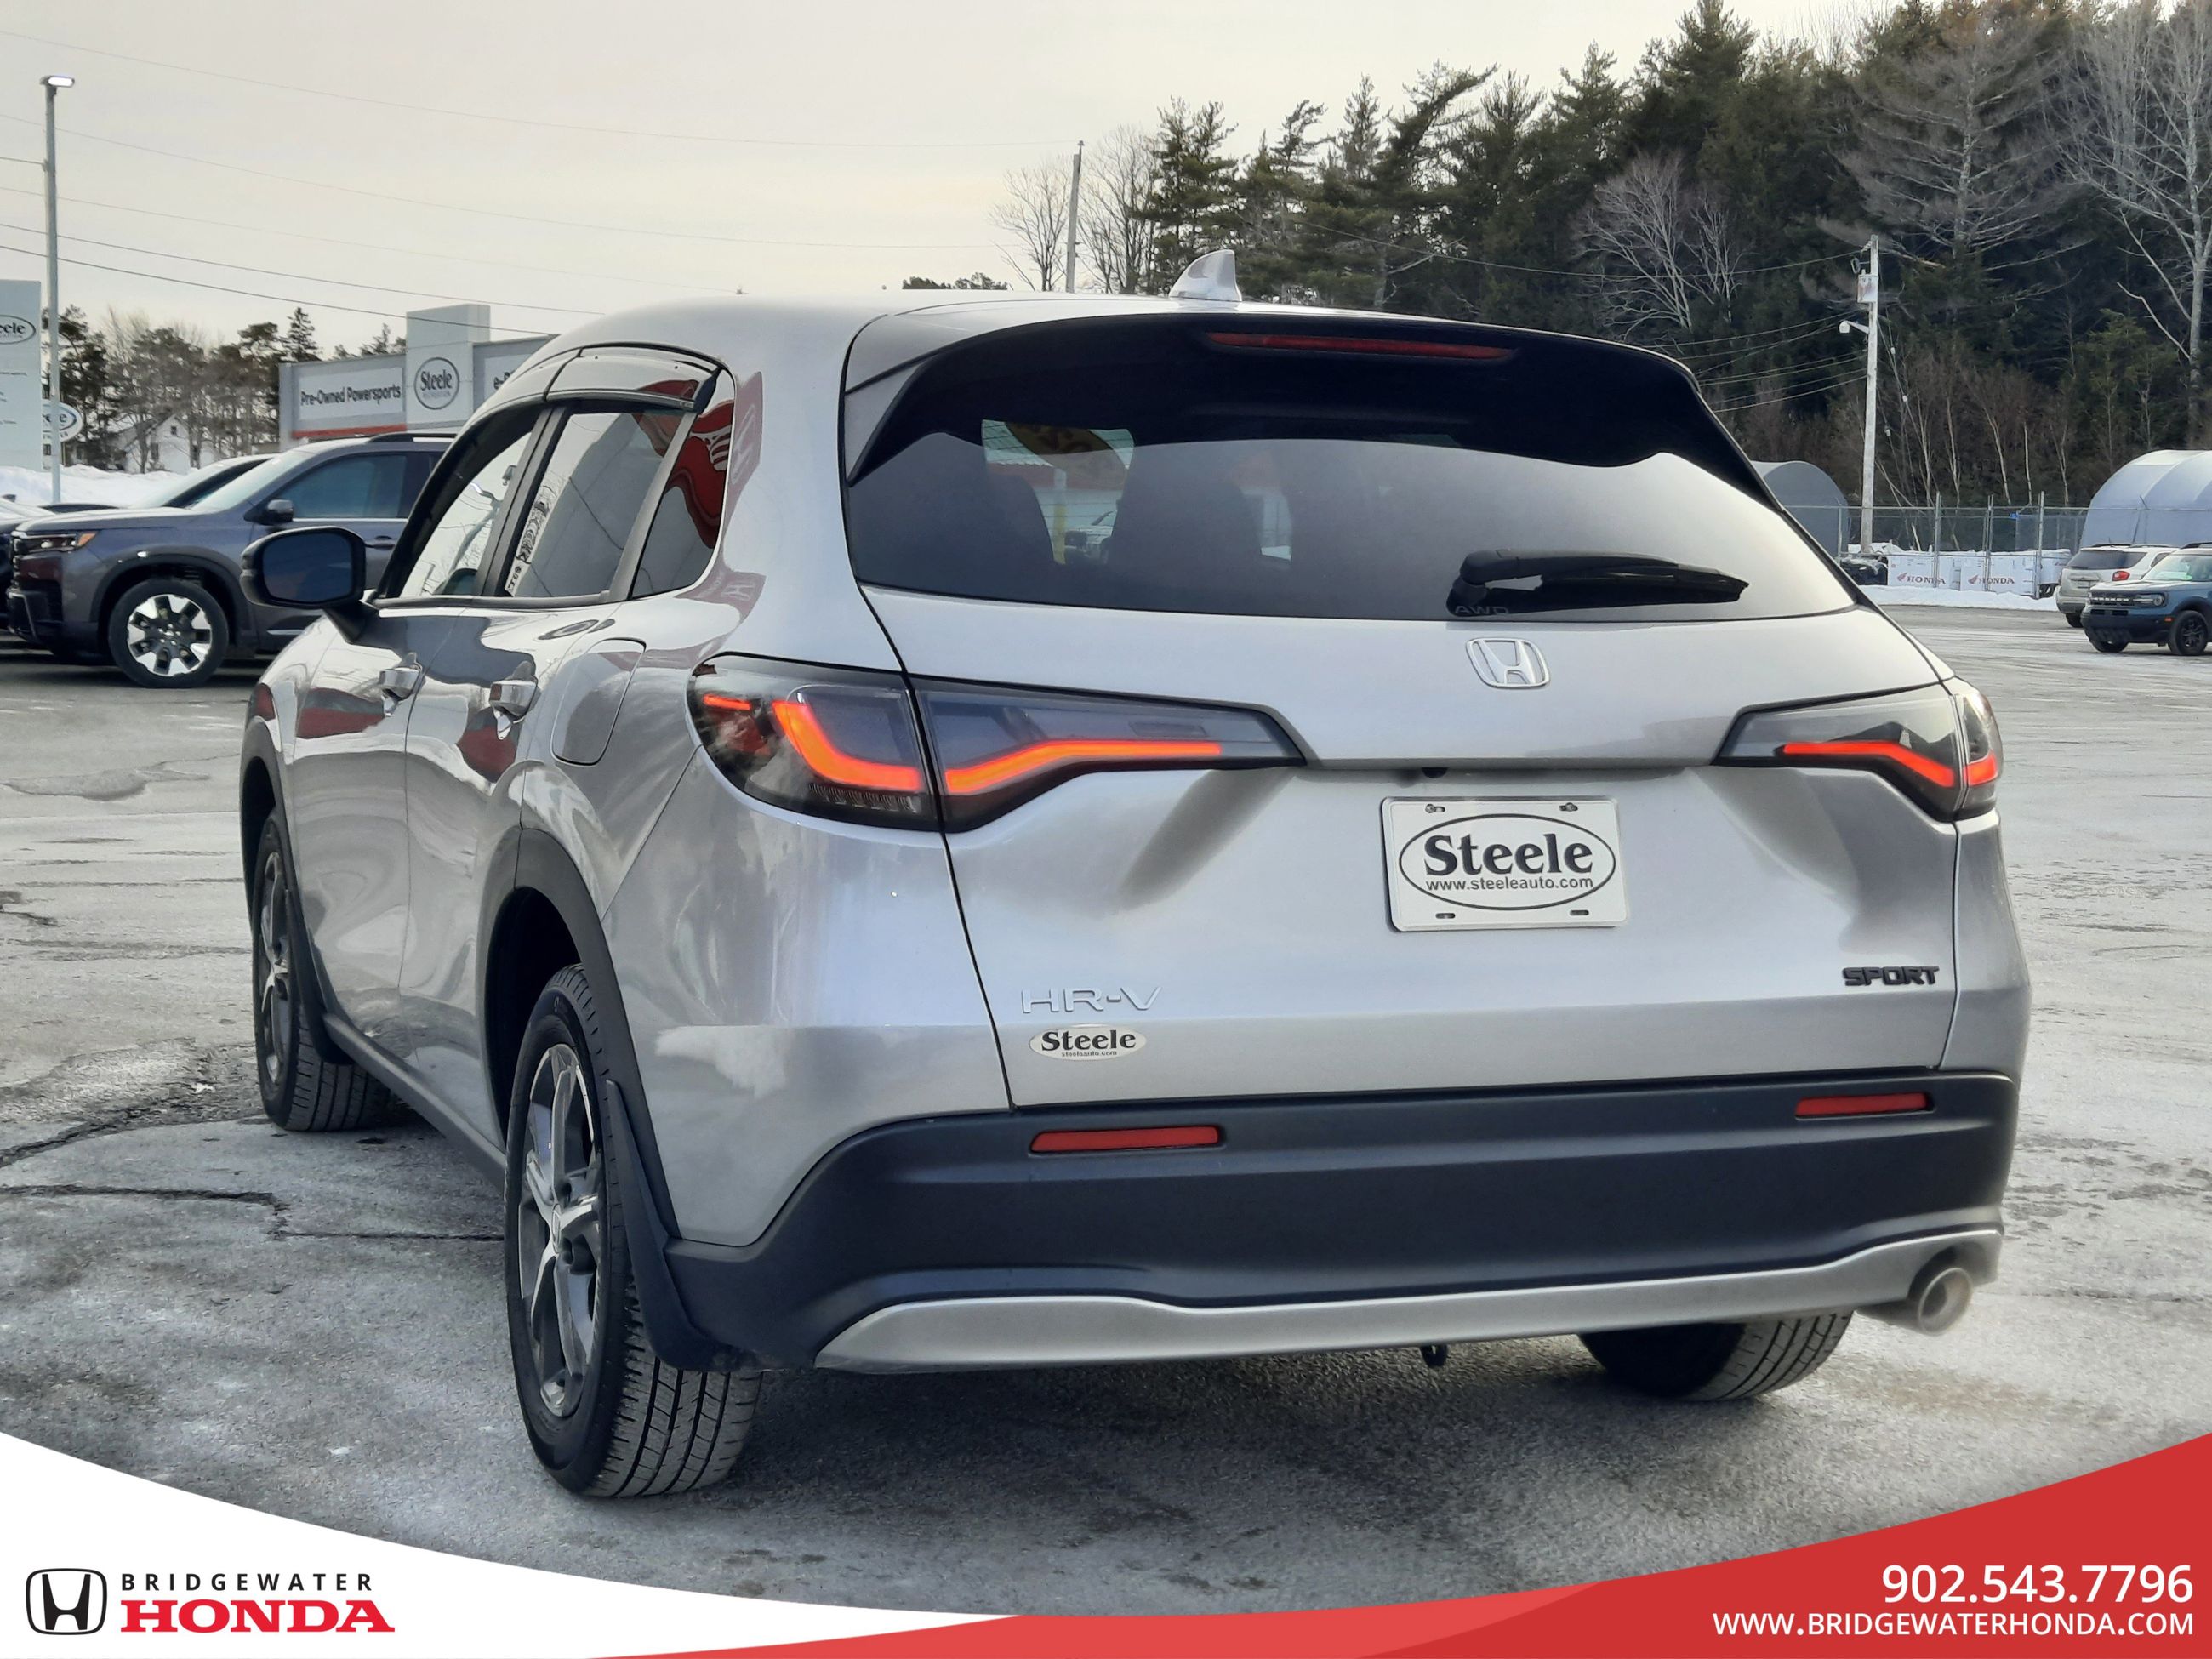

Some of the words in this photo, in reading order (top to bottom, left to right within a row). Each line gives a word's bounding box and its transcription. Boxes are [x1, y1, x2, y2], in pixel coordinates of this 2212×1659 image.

[420, 369, 453, 391] Steele
[300, 386, 345, 406] Pre-Owned
[346, 384, 402, 405] Powersports
[1907, 576, 1946, 584] HONA
[1456, 605, 1509, 614] AWD
[1424, 834, 1593, 875] Steele
[1426, 876, 1593, 891] www.steeleauto.com
[1842, 966, 1940, 986] SPORT
[1021, 987, 1162, 1013] HR-V
[1041, 1030, 1137, 1051] Steele
